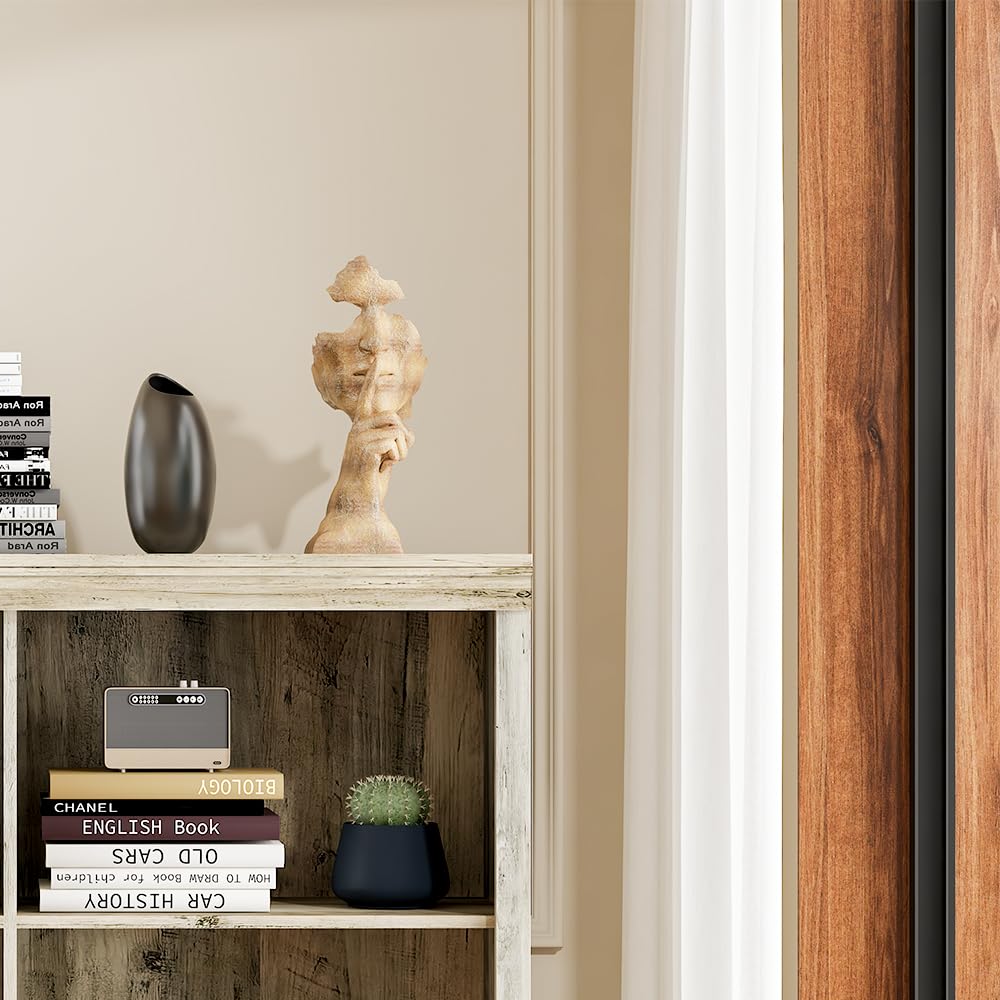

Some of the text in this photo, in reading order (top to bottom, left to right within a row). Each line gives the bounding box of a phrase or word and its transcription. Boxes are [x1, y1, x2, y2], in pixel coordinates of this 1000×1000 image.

[198, 779, 275, 794] BIOLOGY
[54, 803, 118, 812] CHANEL
[83, 819, 219, 834] ENGLISH Book
[113, 849, 217, 864] OLD CARS
[57, 874, 270, 883] HOW TO DRAW Book for children
[85, 894, 224, 908] CAR HISTORY
